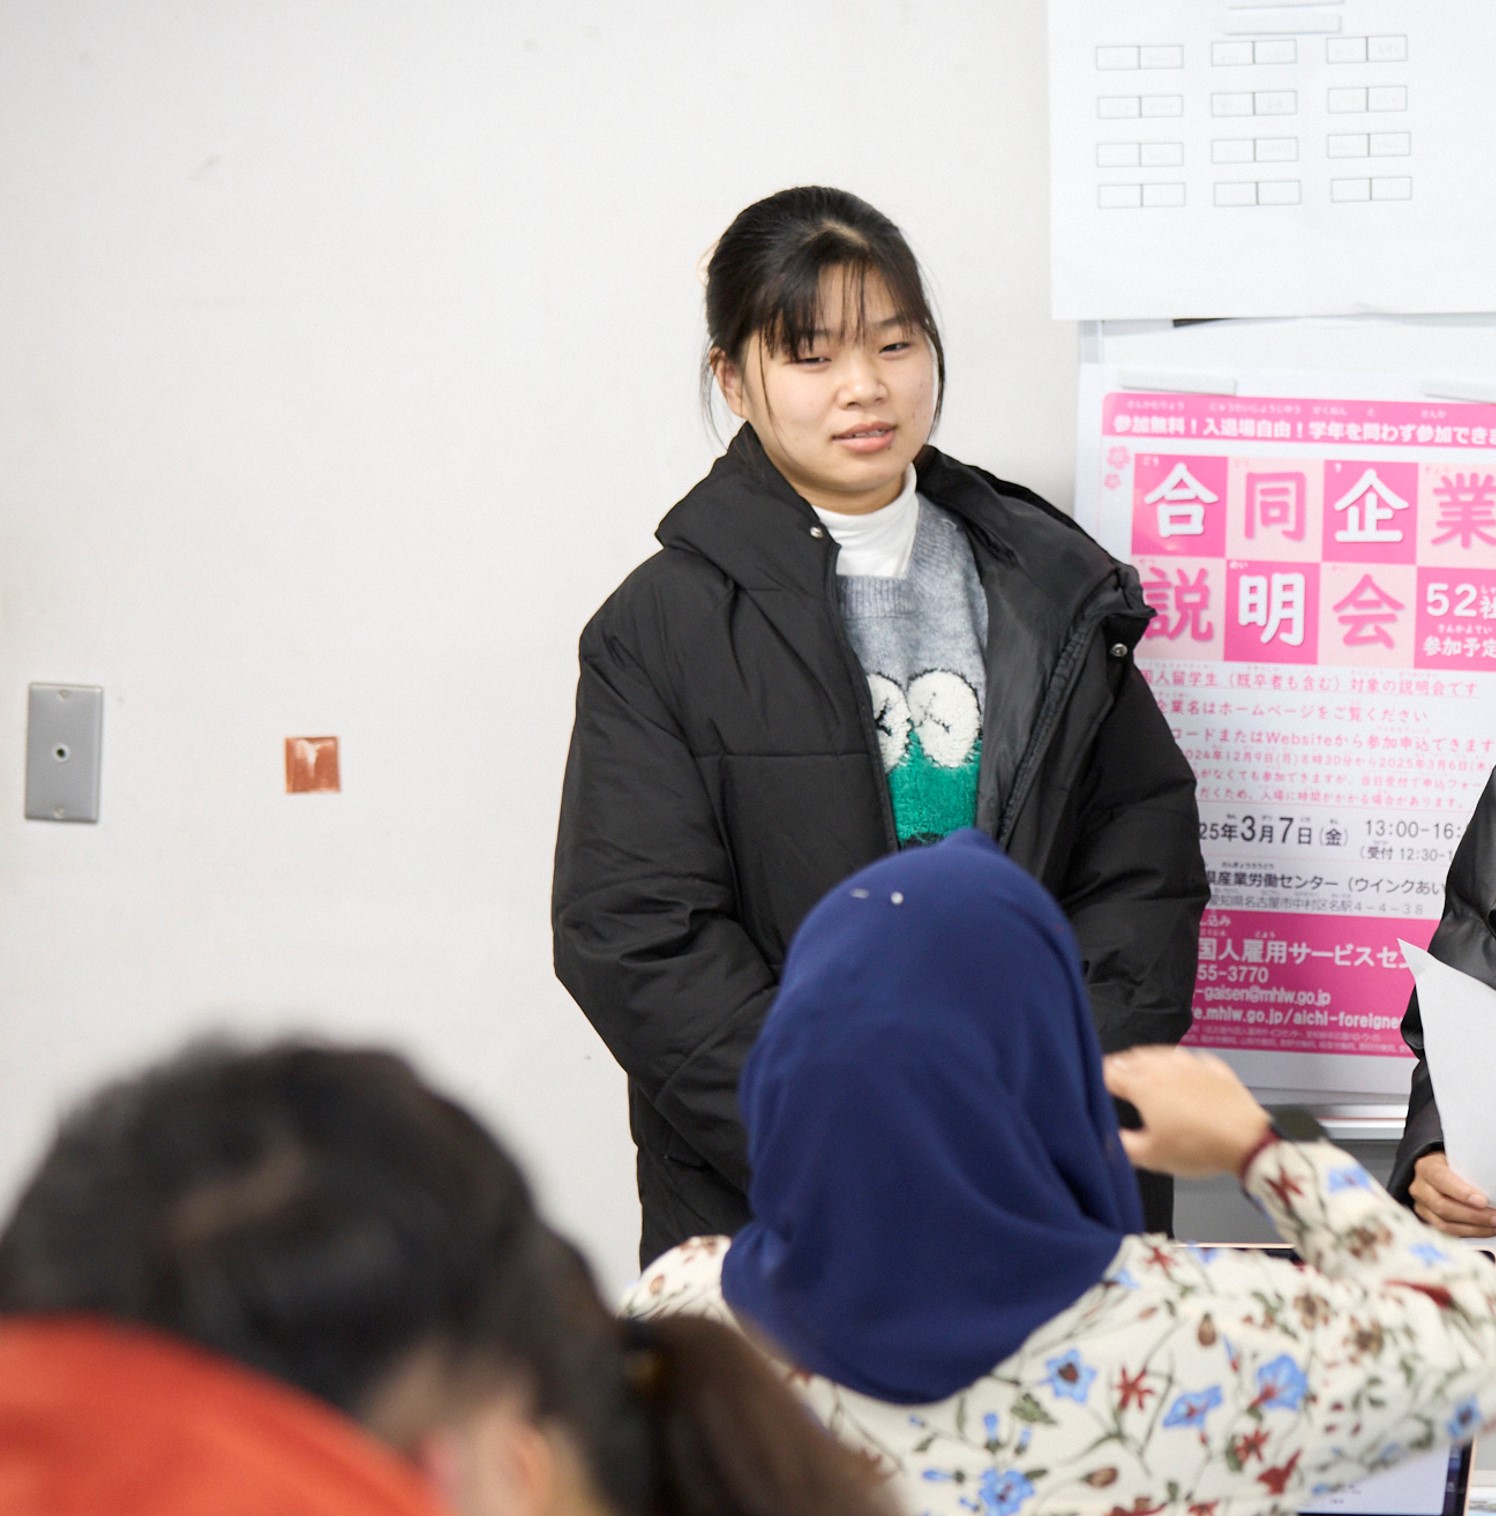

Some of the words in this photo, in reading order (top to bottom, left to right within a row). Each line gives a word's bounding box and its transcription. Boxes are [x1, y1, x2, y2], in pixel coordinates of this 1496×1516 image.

[1141, 567, 1406, 650] 説明会
[1197, 963, 1269, 984] 55-3770
